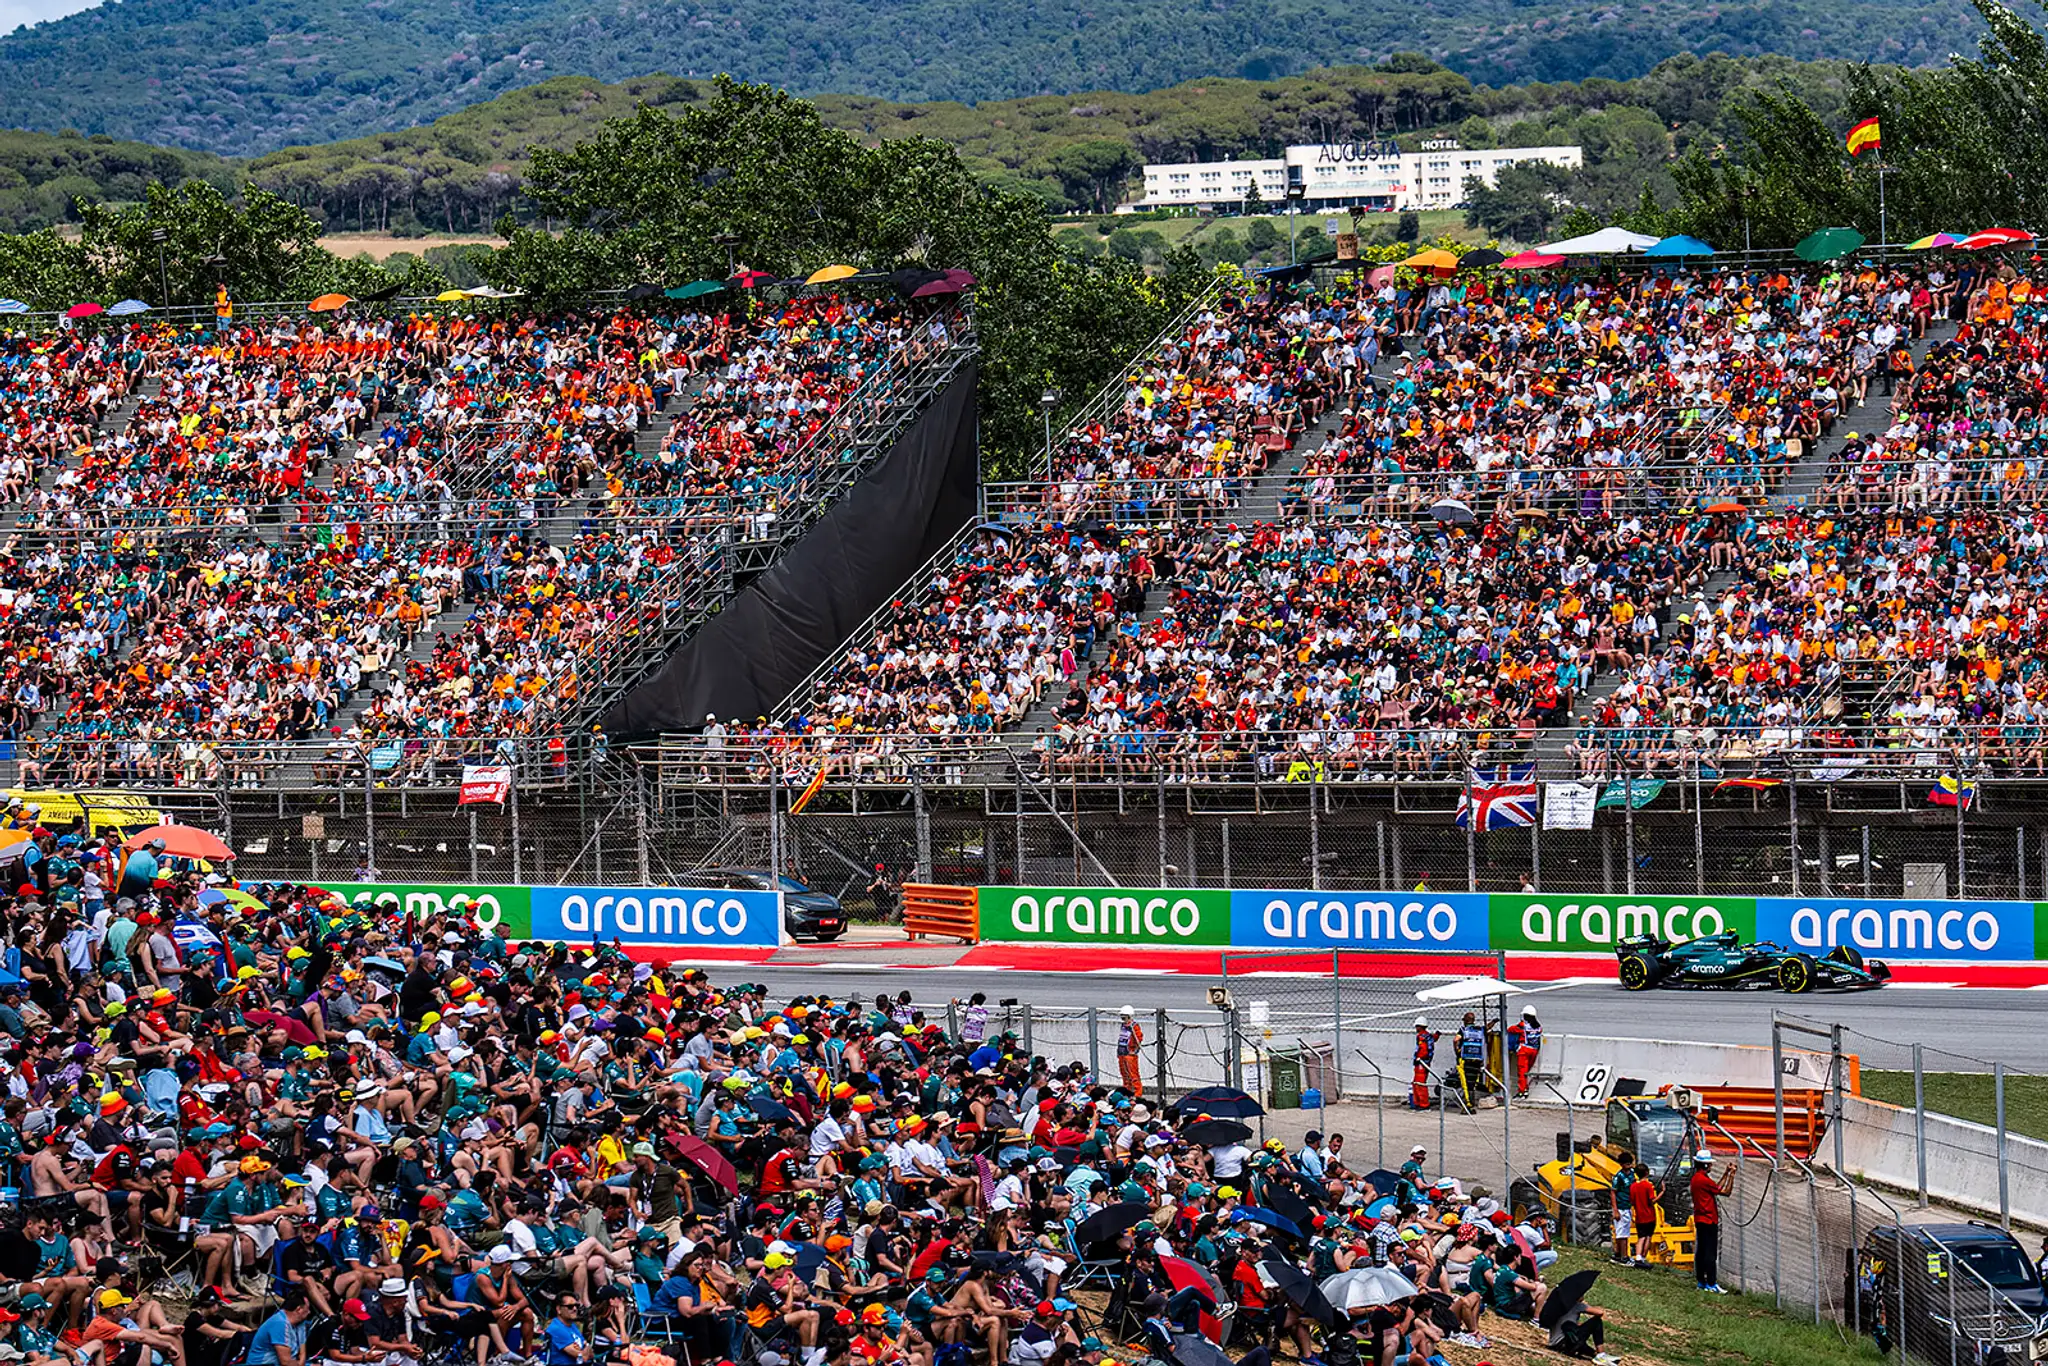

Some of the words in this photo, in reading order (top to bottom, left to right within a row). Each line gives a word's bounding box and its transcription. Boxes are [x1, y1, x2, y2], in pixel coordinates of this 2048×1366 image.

[1319, 139, 1400, 162] AUGUSTA
[1421, 140, 1460, 150] HOTEL
[1605, 789, 1649, 798] araco
[561, 895, 747, 936] aramco
[1011, 895, 1200, 936] aramco
[1263, 900, 1457, 941] aramco
[1522, 903, 1724, 944] aramco
[1790, 907, 1999, 951] aramco
[1691, 964, 1725, 974] aramco
[1784, 1058, 1795, 1072] 10
[1580, 1067, 1606, 1100] SC
